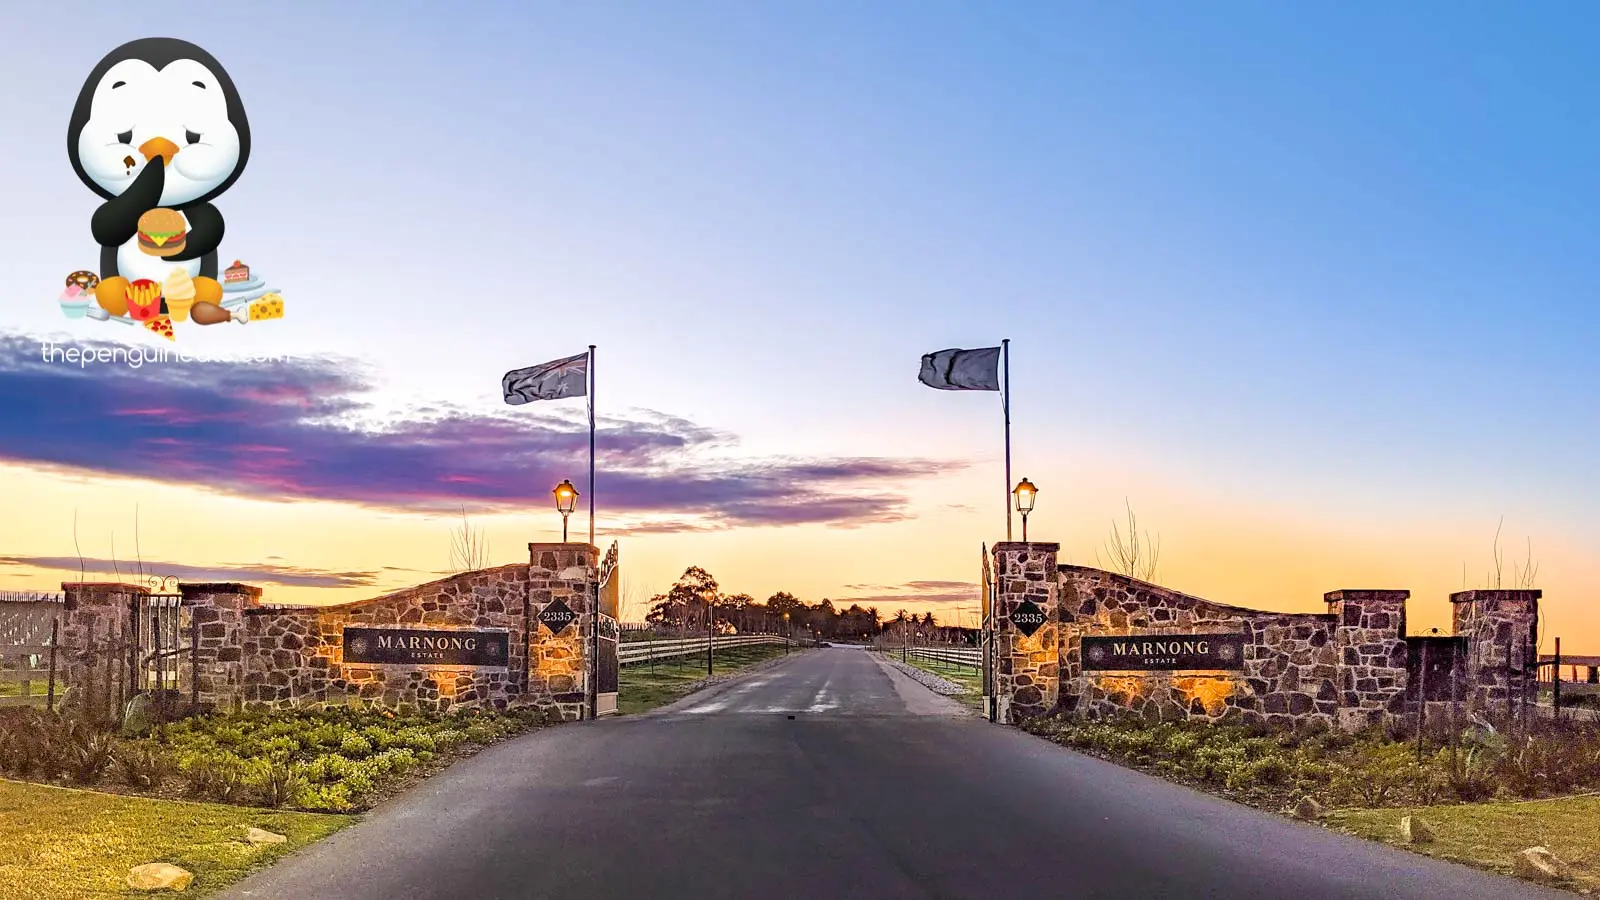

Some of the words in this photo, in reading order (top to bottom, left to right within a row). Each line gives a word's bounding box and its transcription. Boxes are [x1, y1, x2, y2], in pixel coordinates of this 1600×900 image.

[543, 611, 572, 622] 2335
[1013, 613, 1043, 623] 2335
[377, 635, 477, 651] MARNONG
[1112, 641, 1209, 656] MARNONG
